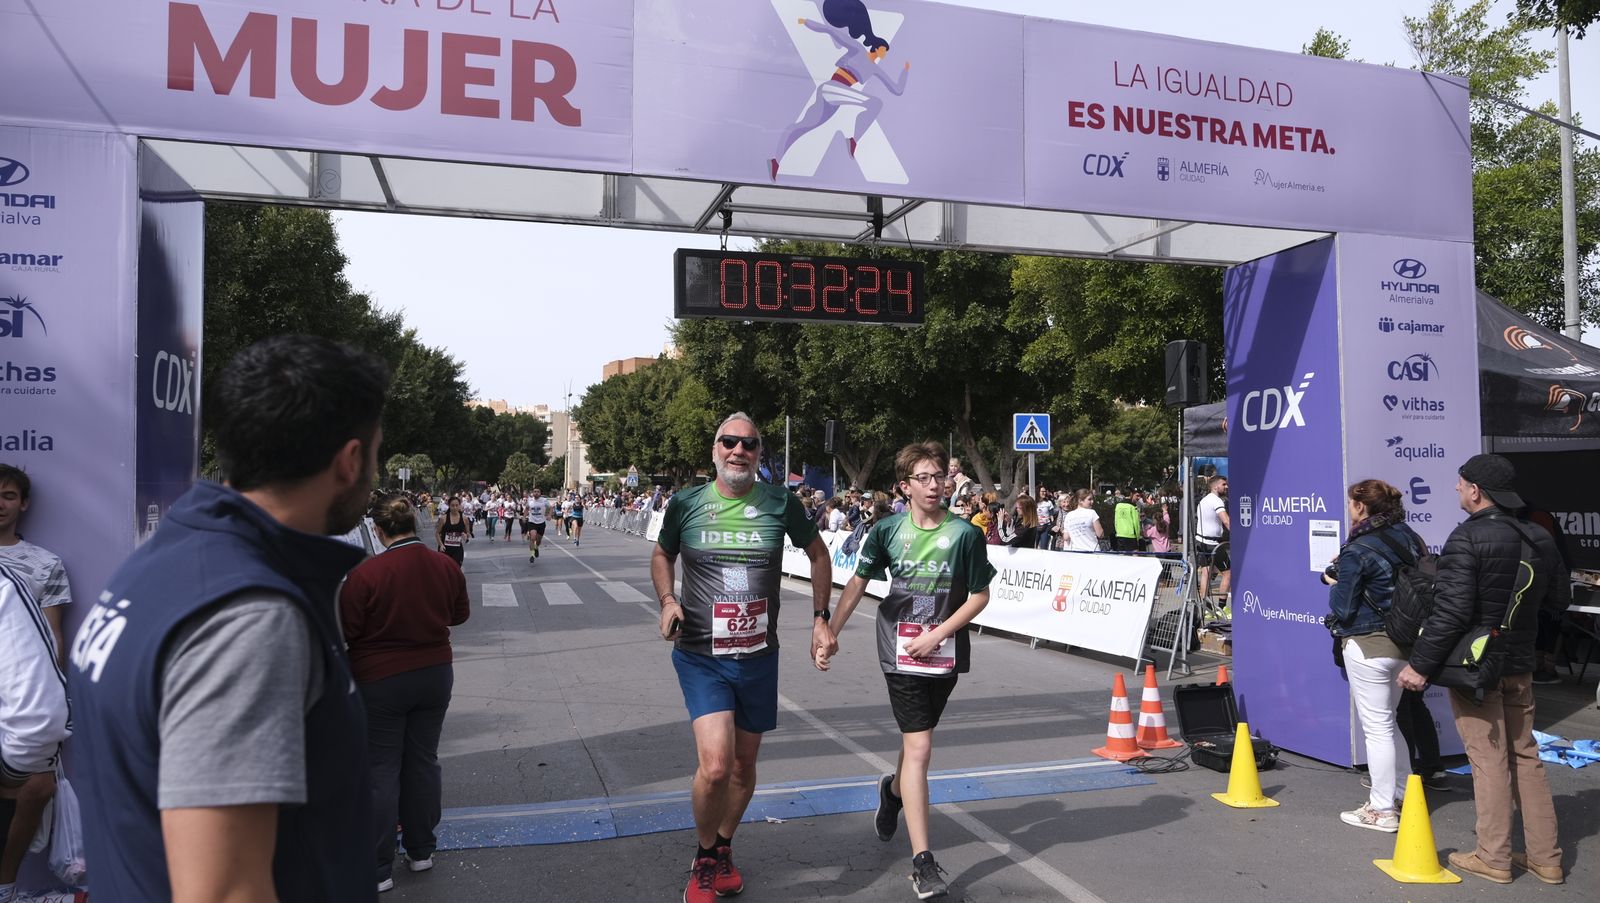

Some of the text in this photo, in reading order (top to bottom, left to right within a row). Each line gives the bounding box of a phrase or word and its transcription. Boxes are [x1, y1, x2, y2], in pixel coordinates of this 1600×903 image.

[166, 1, 582, 127] MUJER
[1113, 61, 1293, 107] LA IGUALDAD
[1067, 100, 1336, 155] ES NUESTRA META.
[1083, 152, 1129, 178] CDX
[1179, 160, 1229, 177] ALMERÍA
[1179, 174, 1206, 184] CIUDAD
[720, 258, 912, 315] 00:32:24
[1381, 281, 1440, 294] HYUNDAI
[1397, 319, 1445, 335] cajamar
[1387, 360, 1429, 381] CASI
[14, 387, 57, 395] cuidarte
[152, 350, 197, 415] CDX
[1242, 372, 1315, 432] CDX
[1401, 396, 1445, 412] vithas
[1394, 443, 1446, 461] aqualia
[1261, 493, 1327, 513] ALMERÍA
[1261, 515, 1293, 526] CIUDAD
[700, 530, 763, 544] IDESA
[1000, 569, 1147, 603] ALMERÍA ALMERÍA
[997, 587, 1112, 616] CIUDAD CIUDAD
[727, 616, 758, 632] 622
